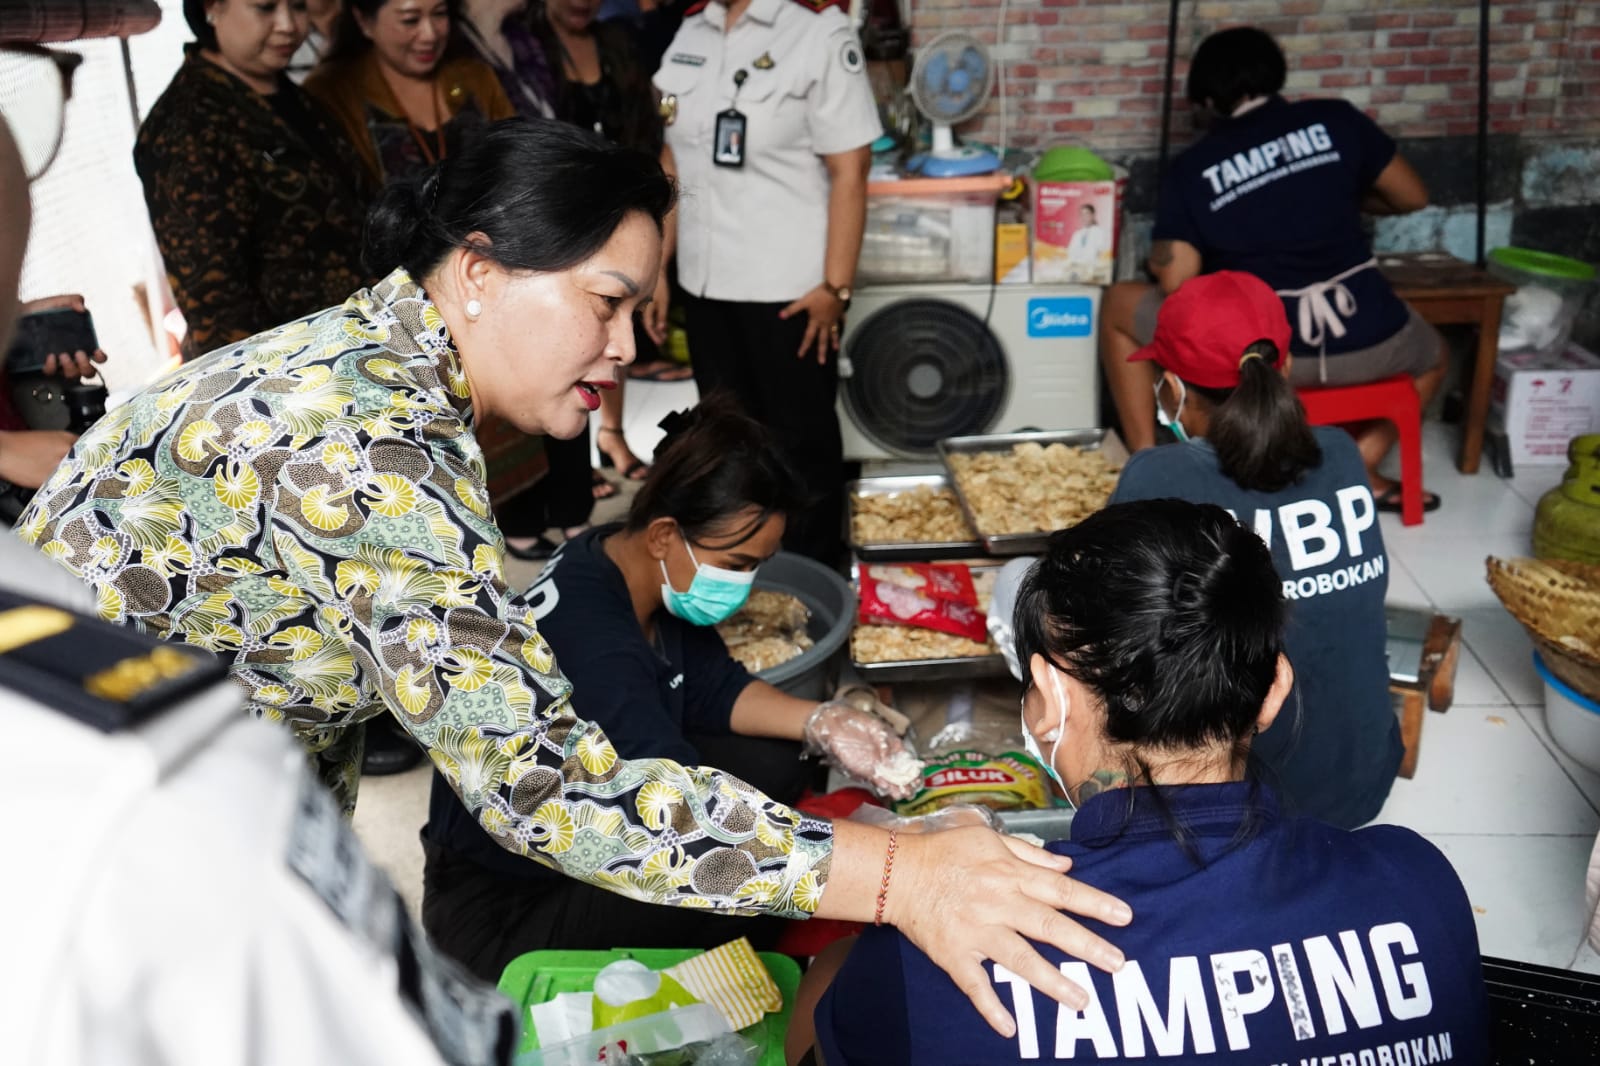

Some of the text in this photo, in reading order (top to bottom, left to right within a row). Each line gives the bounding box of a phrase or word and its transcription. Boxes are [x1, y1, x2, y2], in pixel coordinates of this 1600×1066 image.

[1201, 122, 1333, 194] TAMPING
[1282, 555, 1384, 600] ROBOKAN
[931, 768, 1006, 786] SILUK
[993, 921, 1433, 1059] TAMPING
